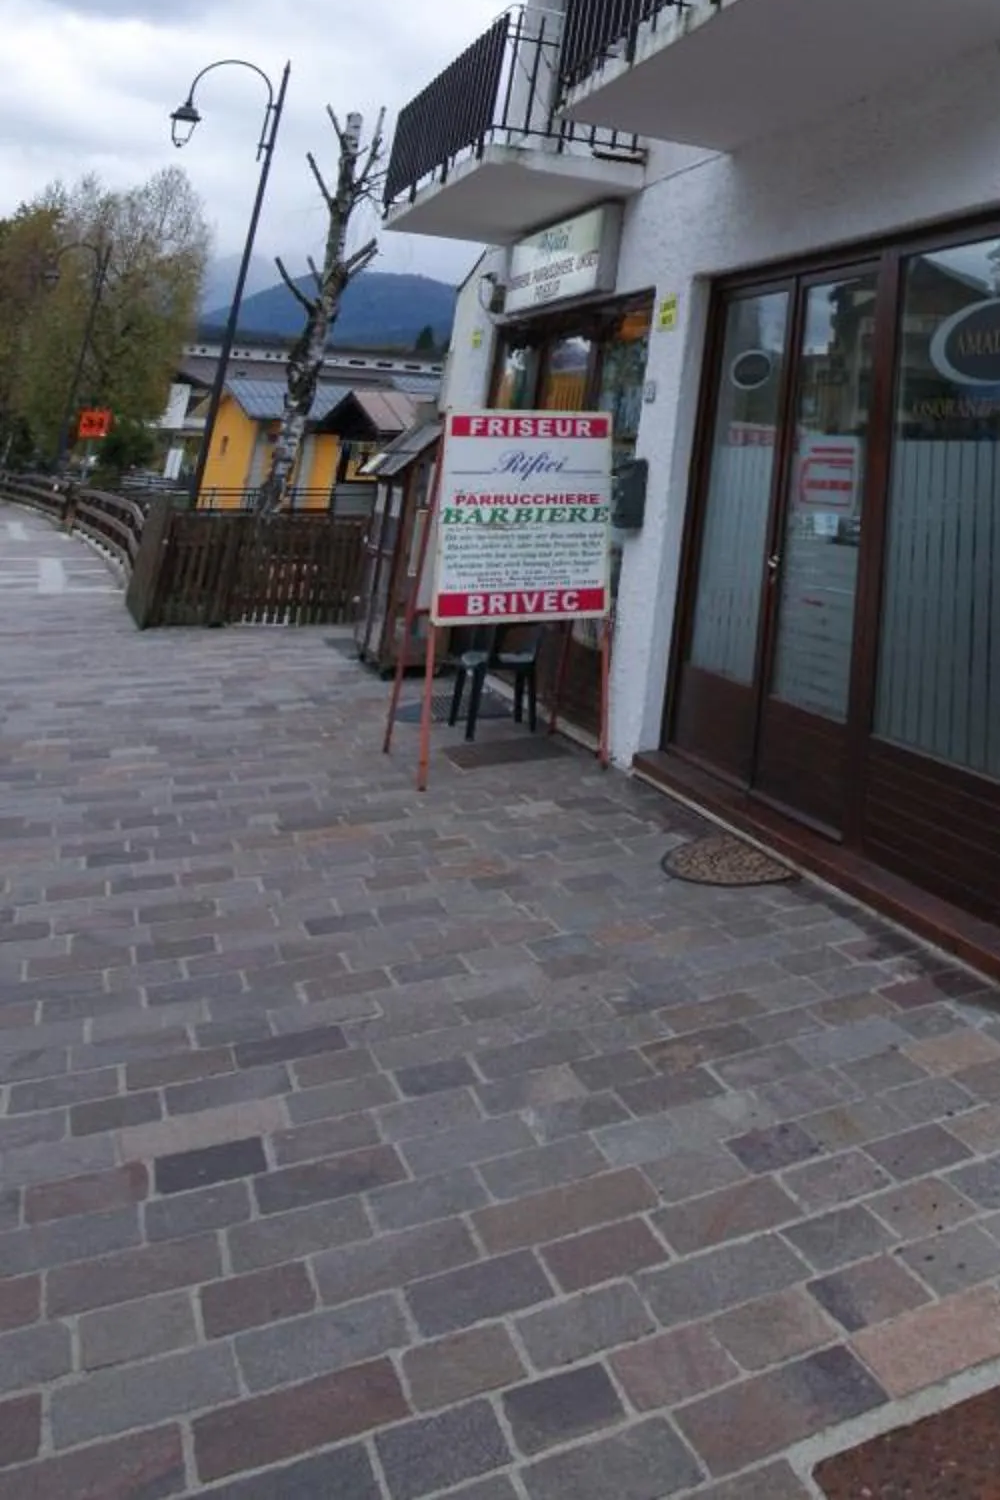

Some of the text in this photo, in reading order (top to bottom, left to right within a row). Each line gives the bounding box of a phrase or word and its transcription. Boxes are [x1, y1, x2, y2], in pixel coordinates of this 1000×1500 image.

[469, 418, 592, 437] FRISEUR
[454, 493, 601, 505] PARRUCCHIERE
[442, 506, 609, 525] BARBIERE
[467, 591, 580, 615] BRIVEC
